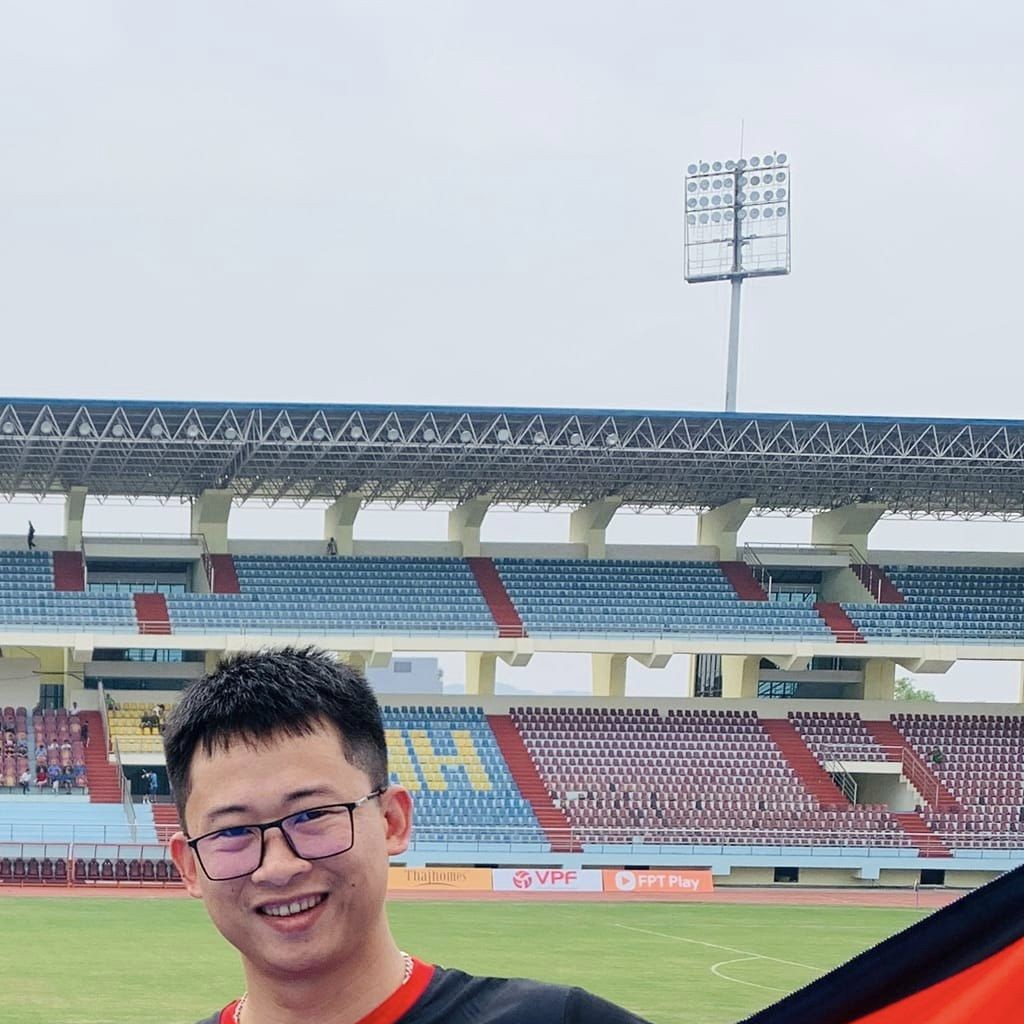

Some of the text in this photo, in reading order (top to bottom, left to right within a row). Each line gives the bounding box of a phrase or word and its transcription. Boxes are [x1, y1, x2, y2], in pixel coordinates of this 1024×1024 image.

[535, 871, 577, 885] VPF
[639, 874, 699, 891] FPT Play
